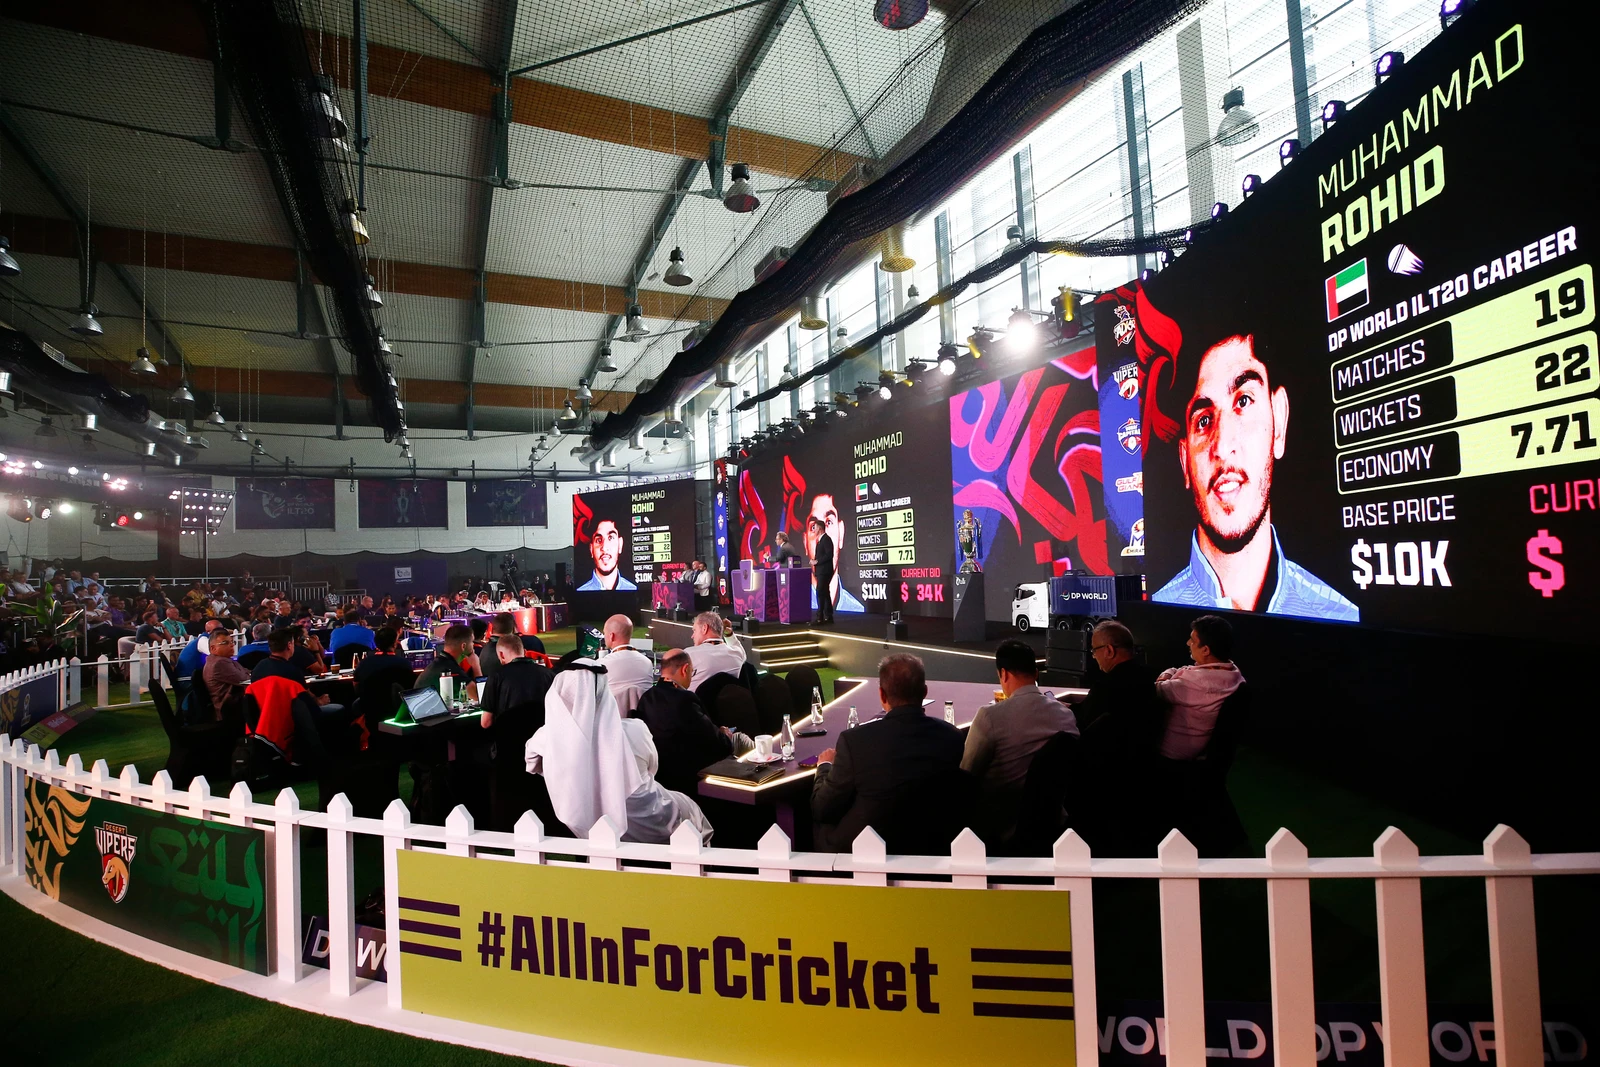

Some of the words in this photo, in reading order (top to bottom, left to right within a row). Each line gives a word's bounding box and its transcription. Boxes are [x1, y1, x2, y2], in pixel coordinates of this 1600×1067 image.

[1318, 23, 1524, 208] MUHAMMAD
[1320, 144, 1446, 263] ROHID
[1328, 328, 1347, 352] DP
[1349, 302, 1408, 343] WORLD
[1411, 273, 1469, 317] ILT20
[1473, 225, 1577, 290] CAREER
[1337, 339, 1425, 391] MATCHES
[1534, 277, 1586, 328] 19
[1340, 394, 1421, 436] WICKETS
[1534, 343, 1591, 392] 22
[854, 431, 902, 458] MUHAMMAD
[1343, 444, 1434, 482] ECONOMY
[1511, 410, 1597, 459] 7.71
[854, 455, 887, 479] ROHID
[1117, 477, 1136, 485] GULF
[632, 490, 665, 502] MUHAMMAD
[632, 502, 654, 514] ROHID
[1529, 478, 1600, 514] CUR
[858, 517, 881, 528] MATCHES
[903, 512, 912, 523] 19
[1342, 502, 1389, 528] BASE
[1393, 494, 1456, 524] PRICE
[859, 534, 880, 545] WICKETS
[903, 531, 913, 542] 22
[860, 552, 883, 562] ECONOMY
[898, 550, 914, 561] 7.71
[1351, 538, 1452, 590] $10K
[1526, 529, 1566, 597] $
[859, 569, 872, 578] BASE
[873, 569, 888, 578] PRICE
[901, 568, 928, 578] CURRENT
[929, 567, 941, 577] BID
[861, 582, 887, 601] $10K
[1071, 592, 1080, 600] DP
[1081, 592, 1108, 600] WORLD
[105, 823, 126, 834] DESERT
[95, 828, 136, 862] VIPERS
[477, 911, 940, 1015] #AllInForCricket
